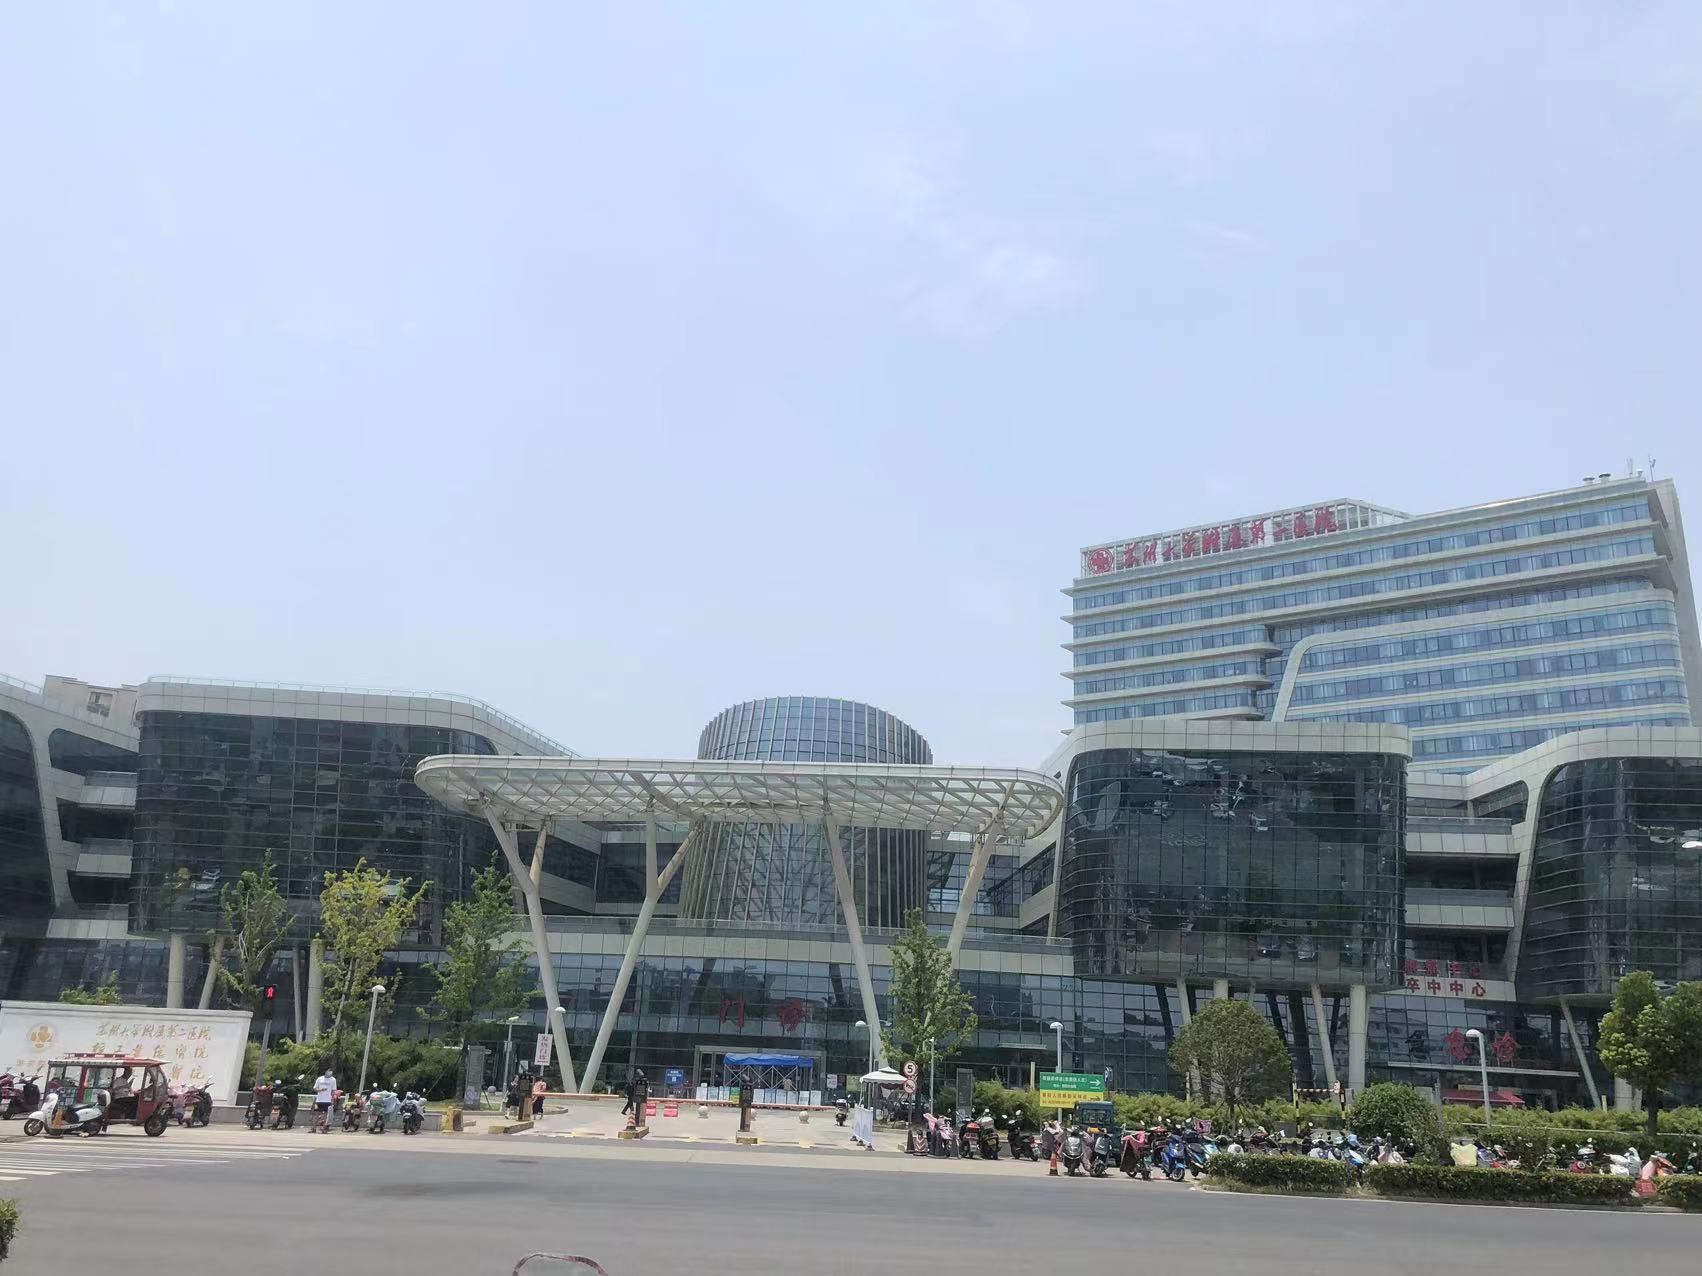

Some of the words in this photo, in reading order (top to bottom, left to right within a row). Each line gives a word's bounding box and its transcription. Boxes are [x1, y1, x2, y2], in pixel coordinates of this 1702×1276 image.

[1406, 977, 1486, 998] 卒中中心
[907, 1064, 914, 1074] 5
